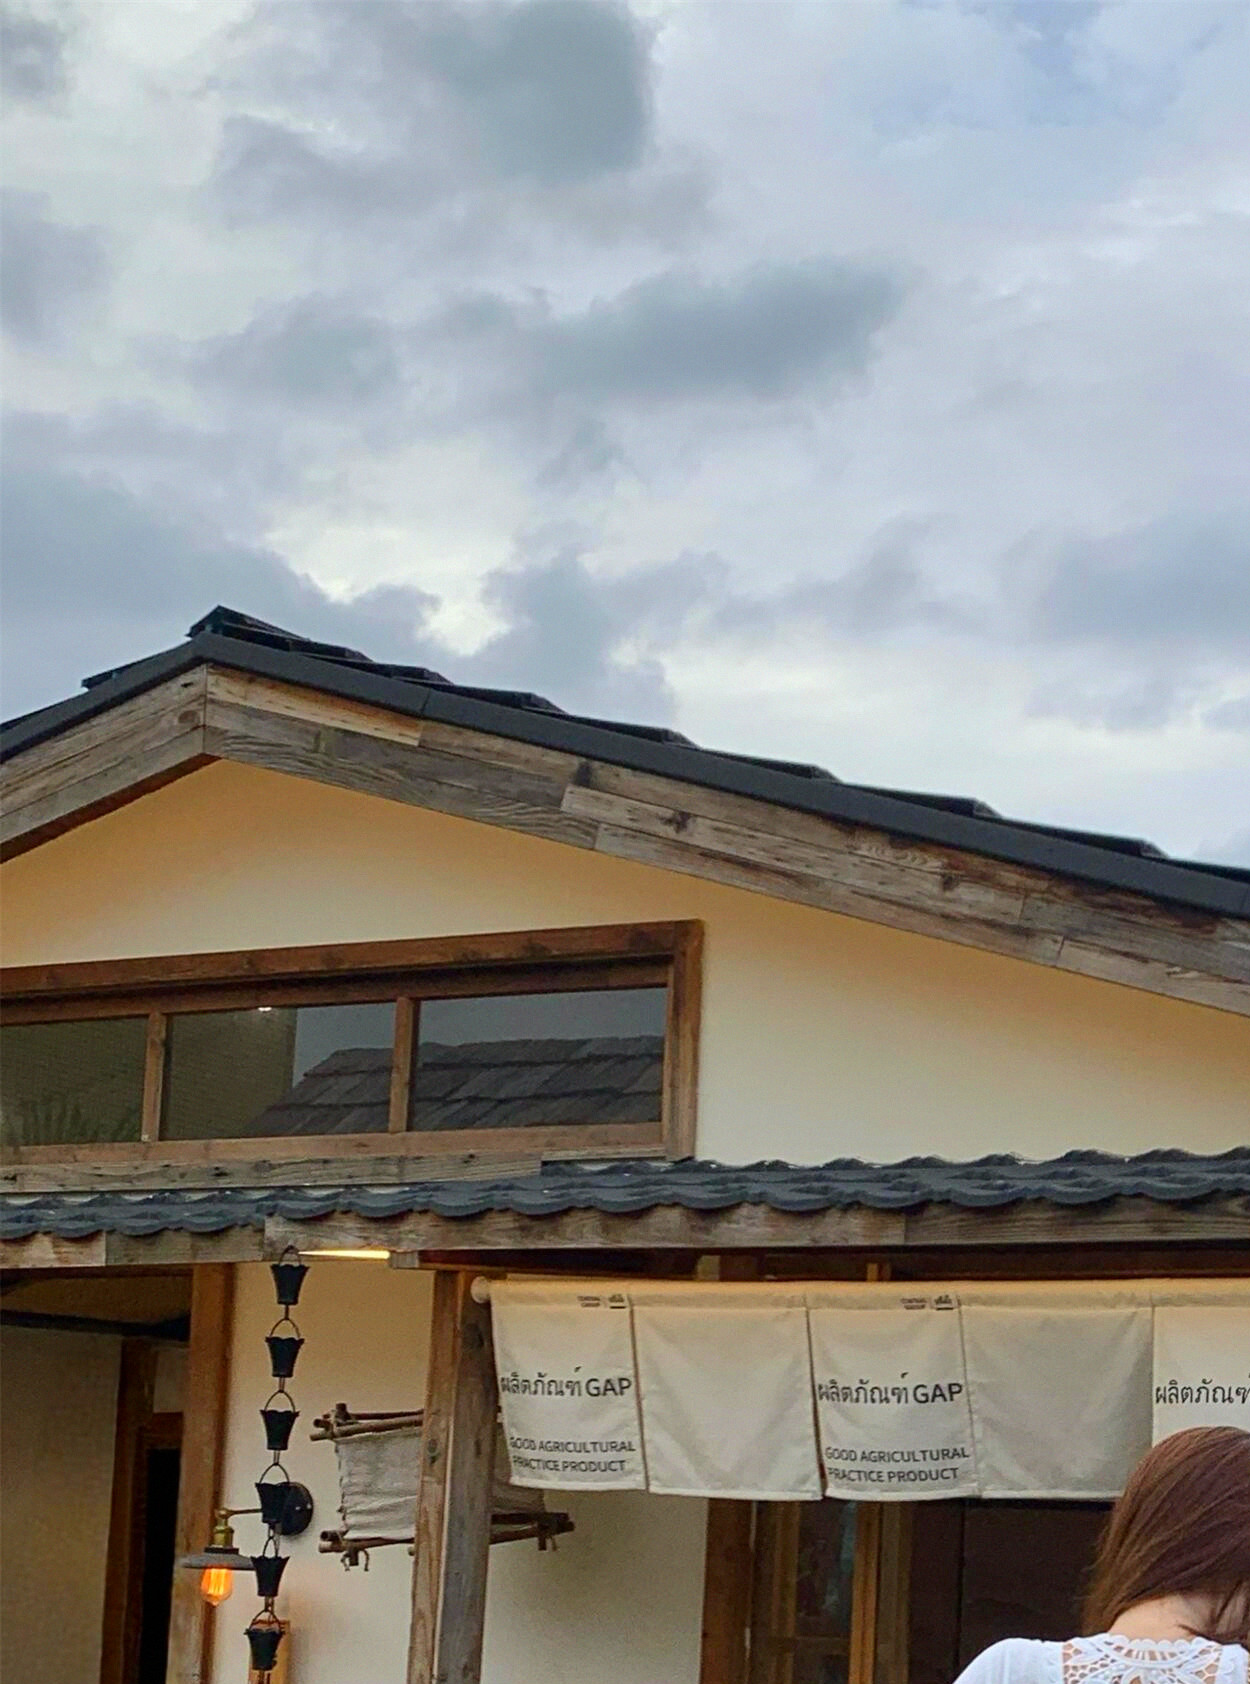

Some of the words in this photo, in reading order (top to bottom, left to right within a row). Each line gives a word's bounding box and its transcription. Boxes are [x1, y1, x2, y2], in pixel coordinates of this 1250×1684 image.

[585, 1378, 632, 1397] GAP
[818, 1372, 909, 1404] ผลิตภัณฑ์
[913, 1382, 963, 1404] GAP
[509, 1437, 536, 1450] GOOD
[539, 1441, 636, 1453] AGRICULTURAL
[825, 1447, 857, 1461] GOOD
[860, 1447, 970, 1462] AGRICULTURAL
[512, 1455, 560, 1472] PRACTICE
[562, 1460, 627, 1473] PRODUCT
[827, 1467, 885, 1482] PRACTICE
[888, 1467, 959, 1483] PRODUCT
